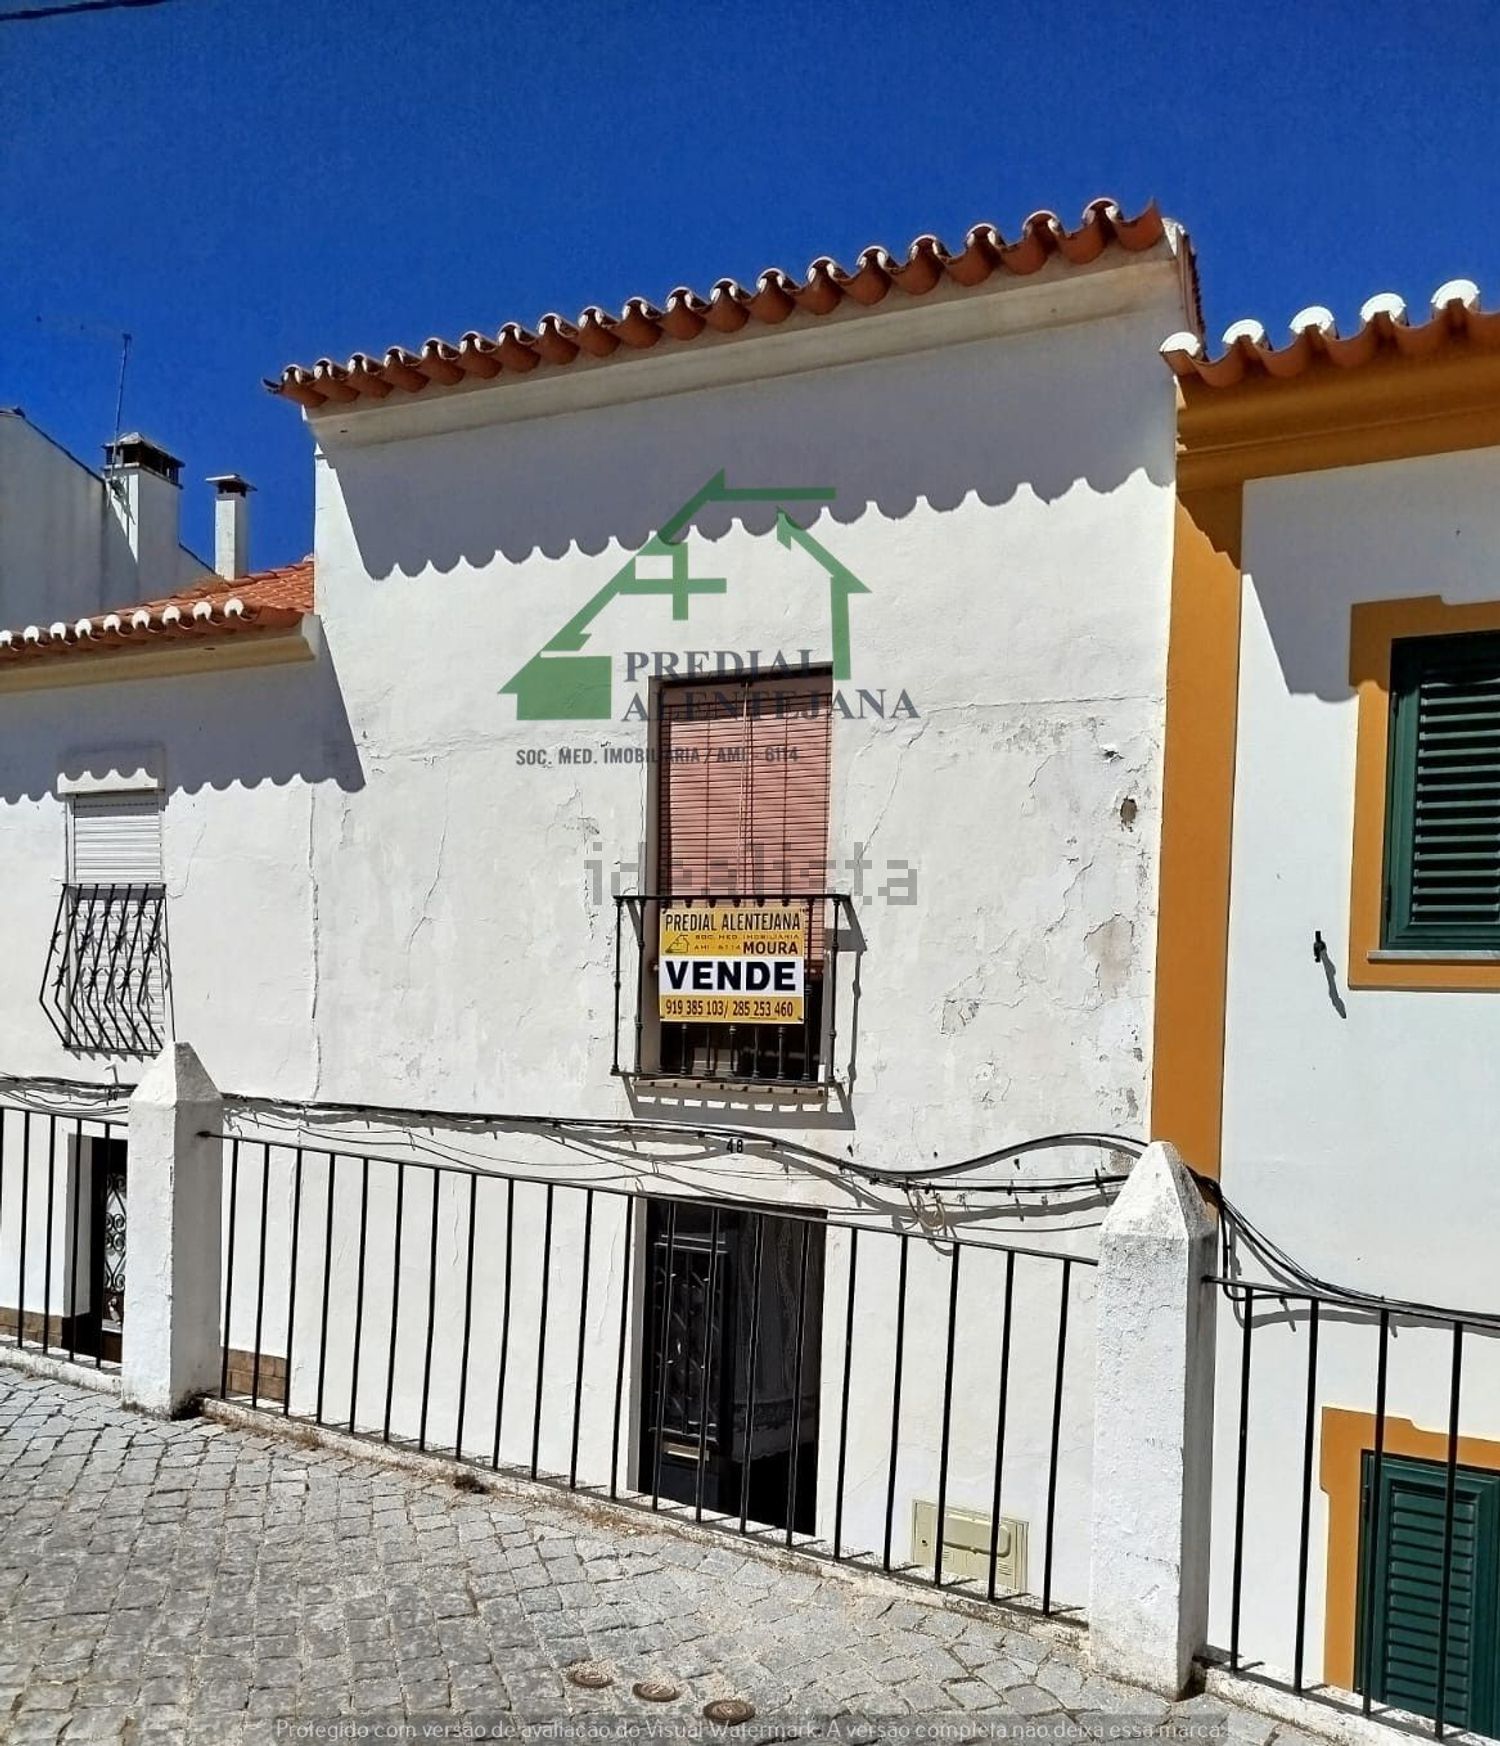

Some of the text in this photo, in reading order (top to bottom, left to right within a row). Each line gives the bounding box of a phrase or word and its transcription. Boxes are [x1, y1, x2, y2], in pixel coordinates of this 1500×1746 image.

[665, 912, 801, 932] PREDIAL ALENTEJANA
[743, 941, 798, 955] MOURA
[665, 961, 796, 991] VENDE
[666, 999, 683, 1015] 919
[686, 1000, 703, 1015] 385
[732, 1001, 750, 1016] 285
[753, 1001, 771, 1016] 253
[774, 1001, 793, 1017] 460
[726, 1137, 744, 1154] 48
